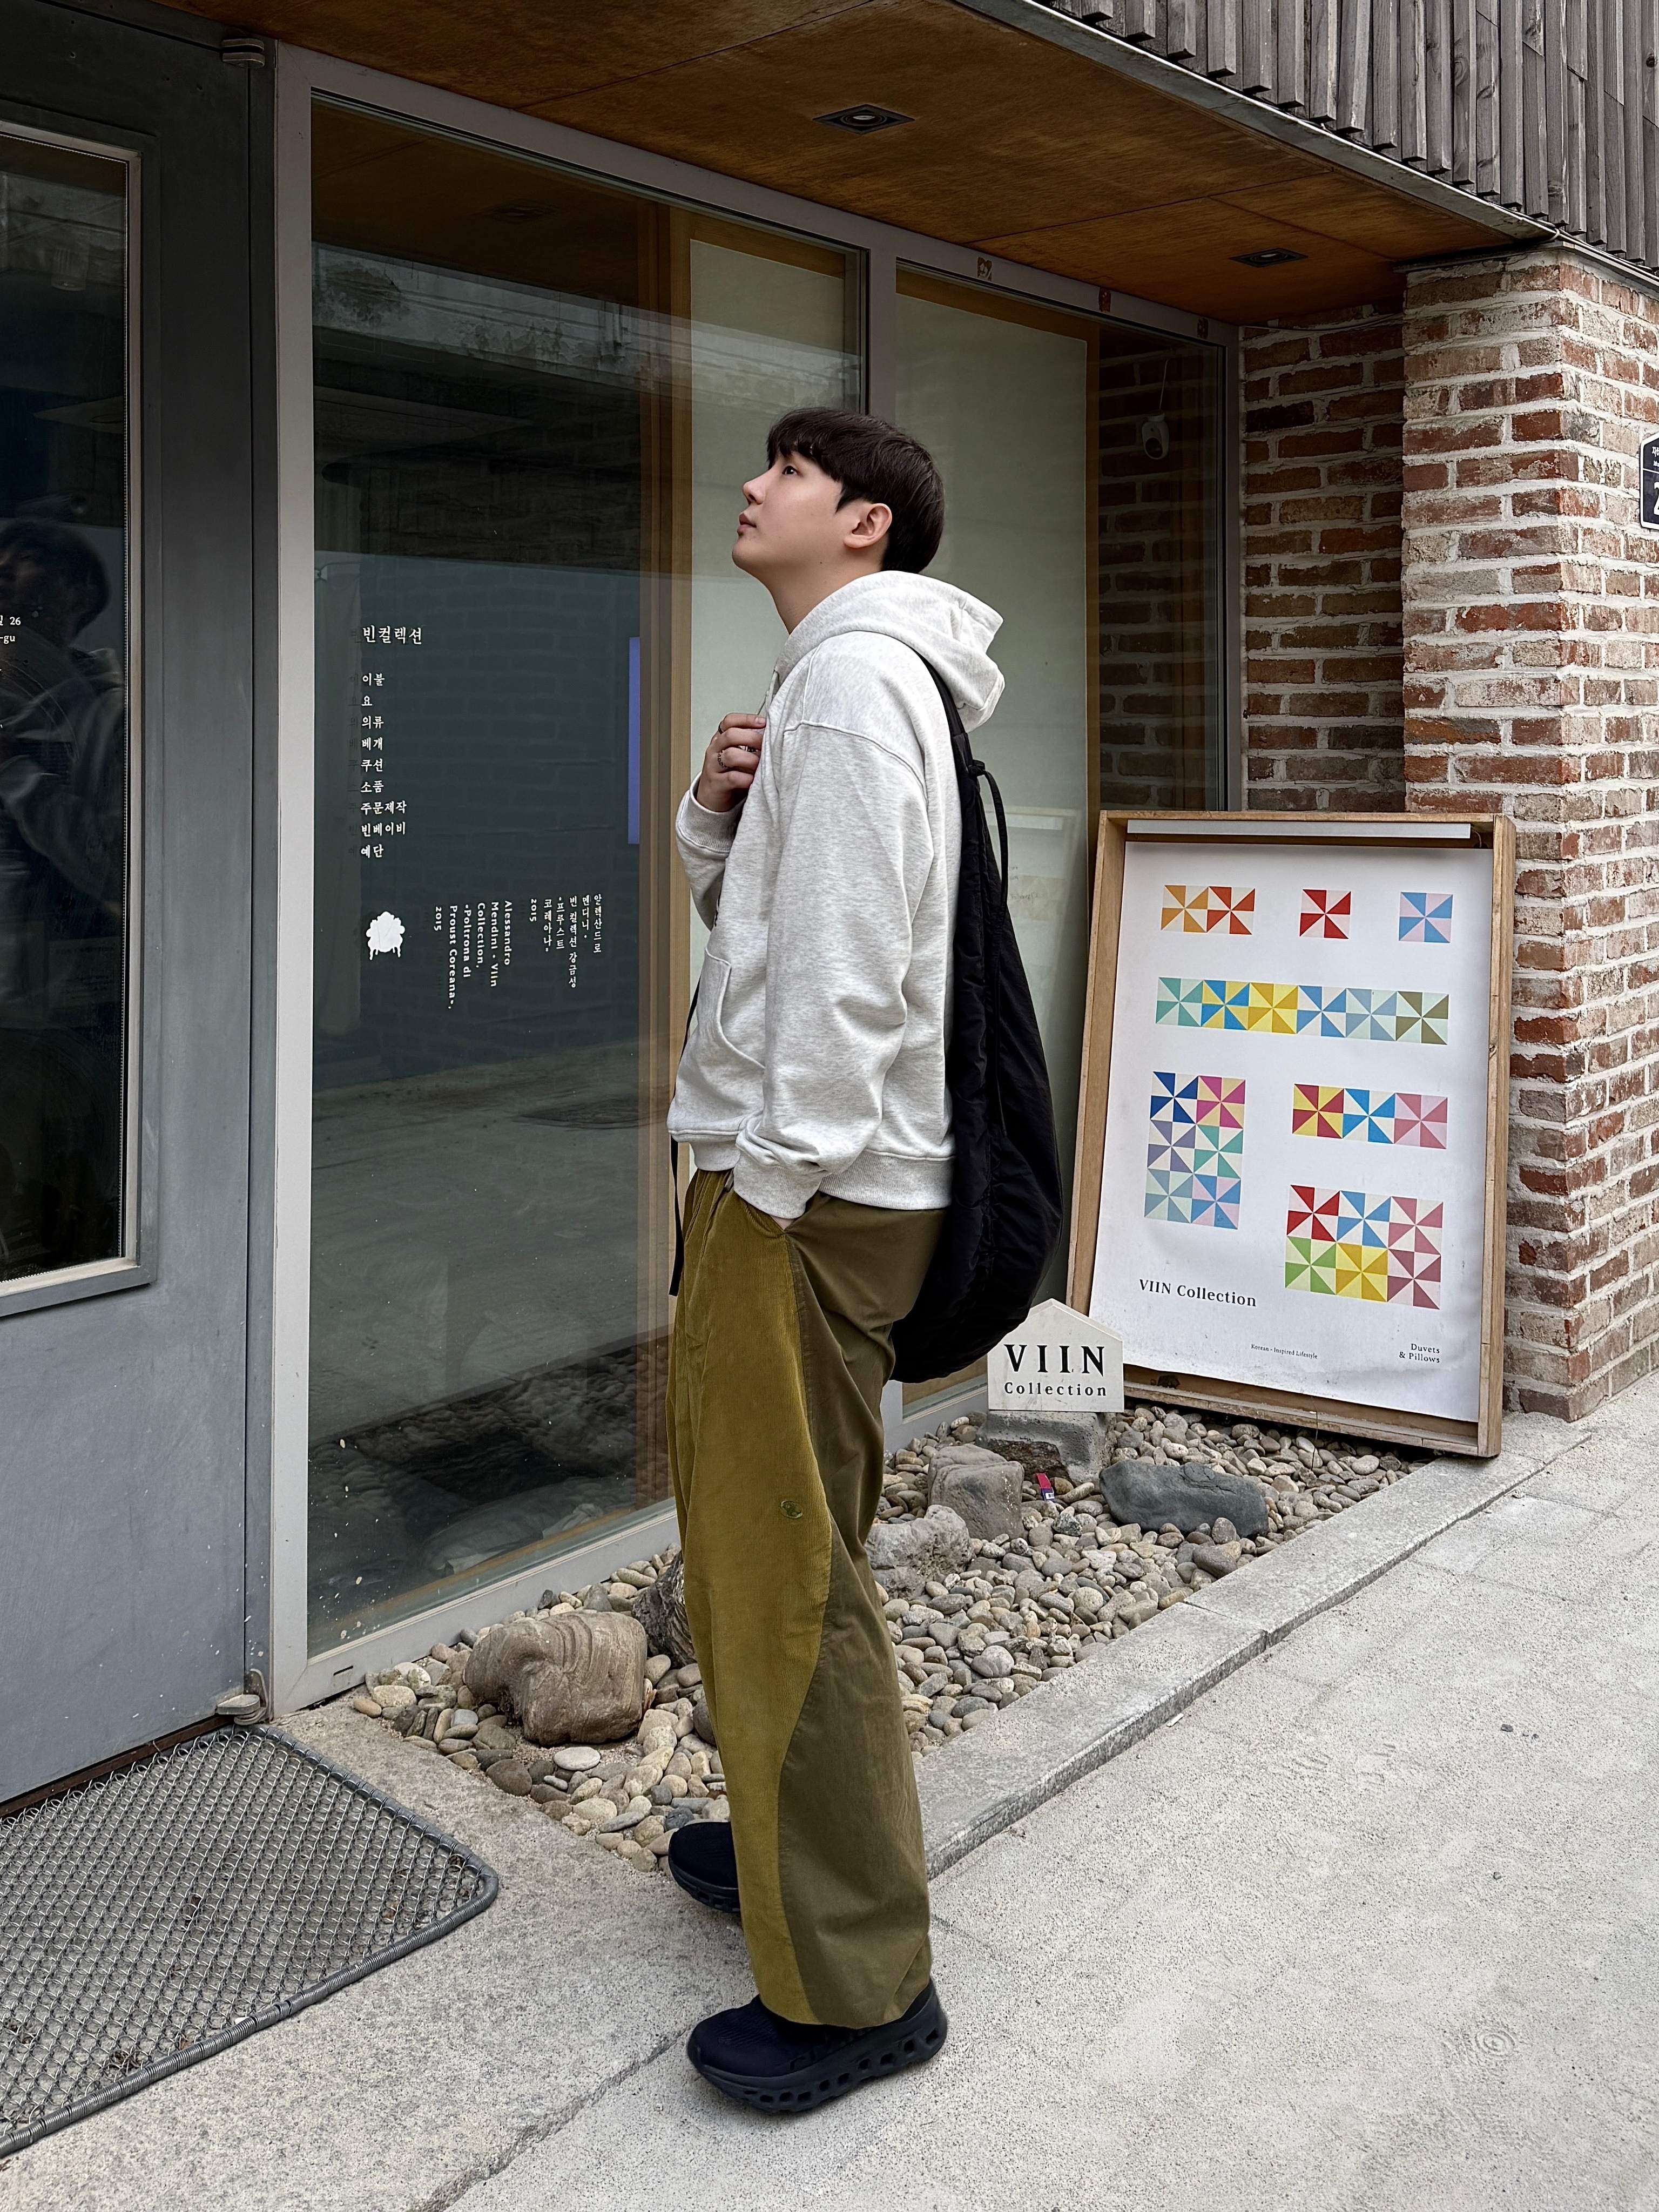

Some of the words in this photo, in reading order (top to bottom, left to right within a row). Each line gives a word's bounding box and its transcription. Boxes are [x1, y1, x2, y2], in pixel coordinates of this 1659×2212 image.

[10, 617, 21, 625] 26
[362, 625, 422, 645] 빈컬렉션
[362, 672, 385, 686] 이불
[361, 695, 373, 706] 요
[361, 715, 384, 730] 의류
[361, 737, 383, 751] 베개
[361, 758, 383, 772] 쿠션
[360, 780, 384, 793] 소품
[360, 800, 407, 815] 주문제작
[361, 821, 406, 837] 빈베이비
[361, 844, 384, 859] 예단
[569, 895, 577, 907] 빈
[434, 906, 442, 931] 2015
[449, 905, 458, 945] Proust
[491, 902, 499, 949] Mendini
[593, 894, 603, 953] 알렉산드로
[476, 902, 485, 968] Collection,
[504, 900, 512, 965] Alessandro
[569, 911, 577, 948] 컬렉션
[463, 966, 471, 977] di
[568, 952, 578, 988] 강금성
[1139, 1279, 1171, 1294] VIIN
[1177, 1285, 1256, 1307] Collection
[1274, 1347, 1294, 1355] Inspired
[1296, 1351, 1318, 1359] Lifestyle
[1411, 1343, 1440, 1354] Duvets
[1003, 1344, 1105, 1377] VIIN
[1409, 1352, 1440, 1363] Pillows
[1004, 1382, 1106, 1396] Collection
